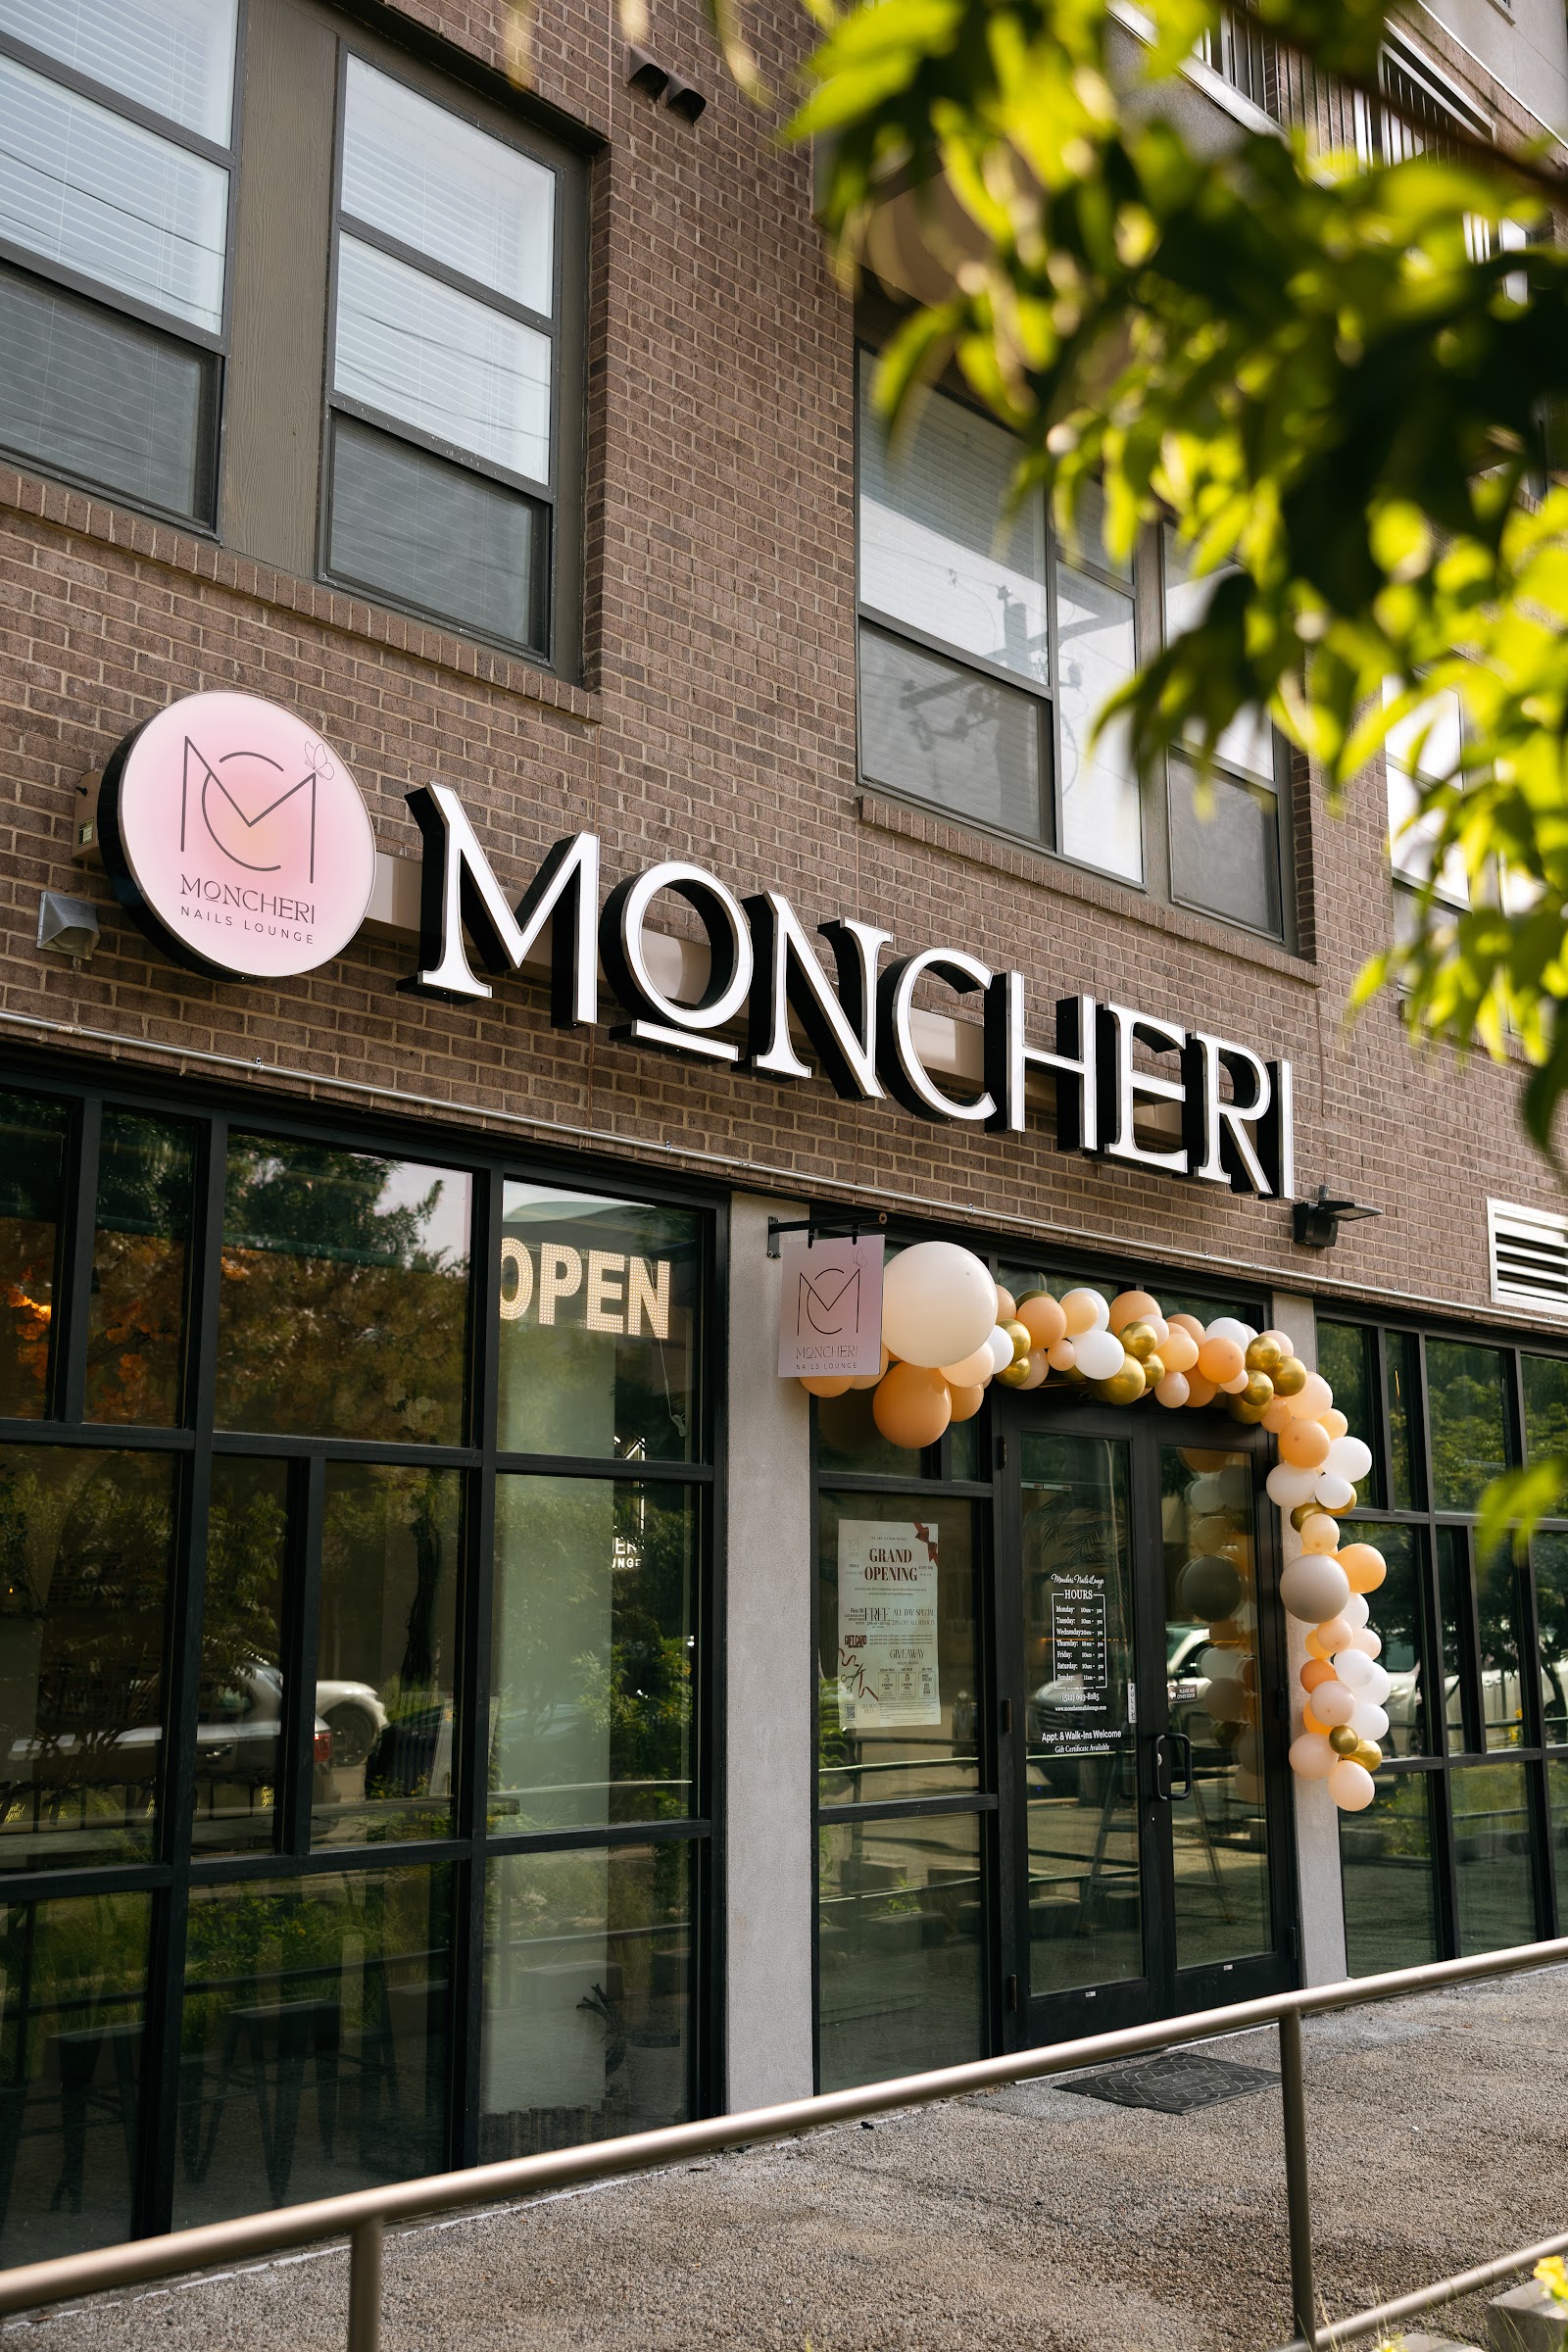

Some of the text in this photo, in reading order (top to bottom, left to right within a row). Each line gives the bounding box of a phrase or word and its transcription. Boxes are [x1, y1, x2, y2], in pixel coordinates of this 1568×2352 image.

[180, 873, 315, 924] MONCHERI
[180, 906, 314, 945] NAILS LOUNGE
[412, 782, 1295, 1200] MONCHERI
[499, 1237, 671, 1340] OPEN
[796, 1346, 858, 1359] MONCHERI
[869, 1548, 912, 1563] GRAND
[864, 1566, 918, 1582] OPENING
[1064, 1590, 1093, 1600] HOURS
[864, 1607, 891, 1622] FREE
[915, 1608, 935, 1617] SPECIAL
[844, 1635, 867, 1645] GIFT CARD
[889, 1648, 925, 1659] GIVEAWAY
[1061, 1692, 1075, 1702] (512)
[1042, 1732, 1058, 1743] Appt.
[1064, 1730, 1093, 1740] Walk-Ins
[1093, 1729, 1121, 1739] Welcome
[1065, 1744, 1090, 1753] Certificate
[1090, 1742, 1109, 1751] Available
